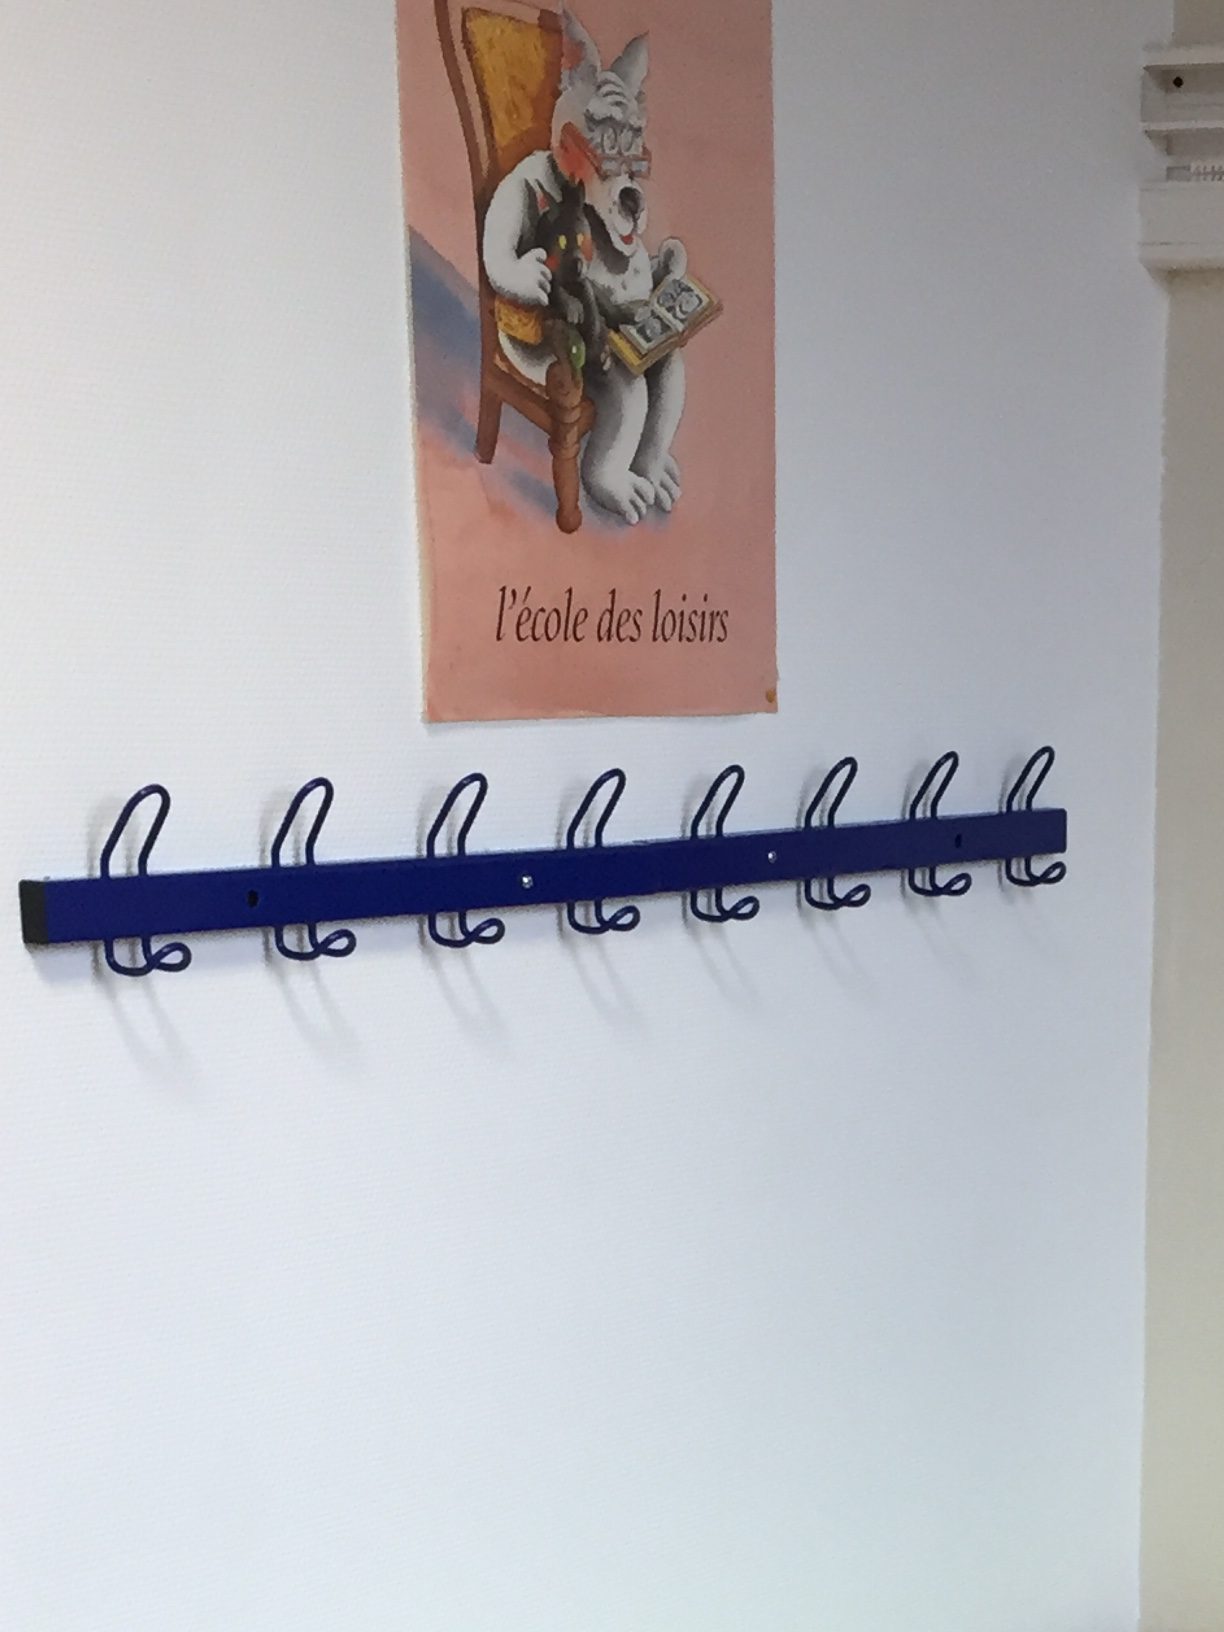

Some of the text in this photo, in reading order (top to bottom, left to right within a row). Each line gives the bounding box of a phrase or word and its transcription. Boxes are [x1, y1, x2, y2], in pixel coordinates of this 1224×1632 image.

[495, 585, 730, 643] l'école des loisirs
